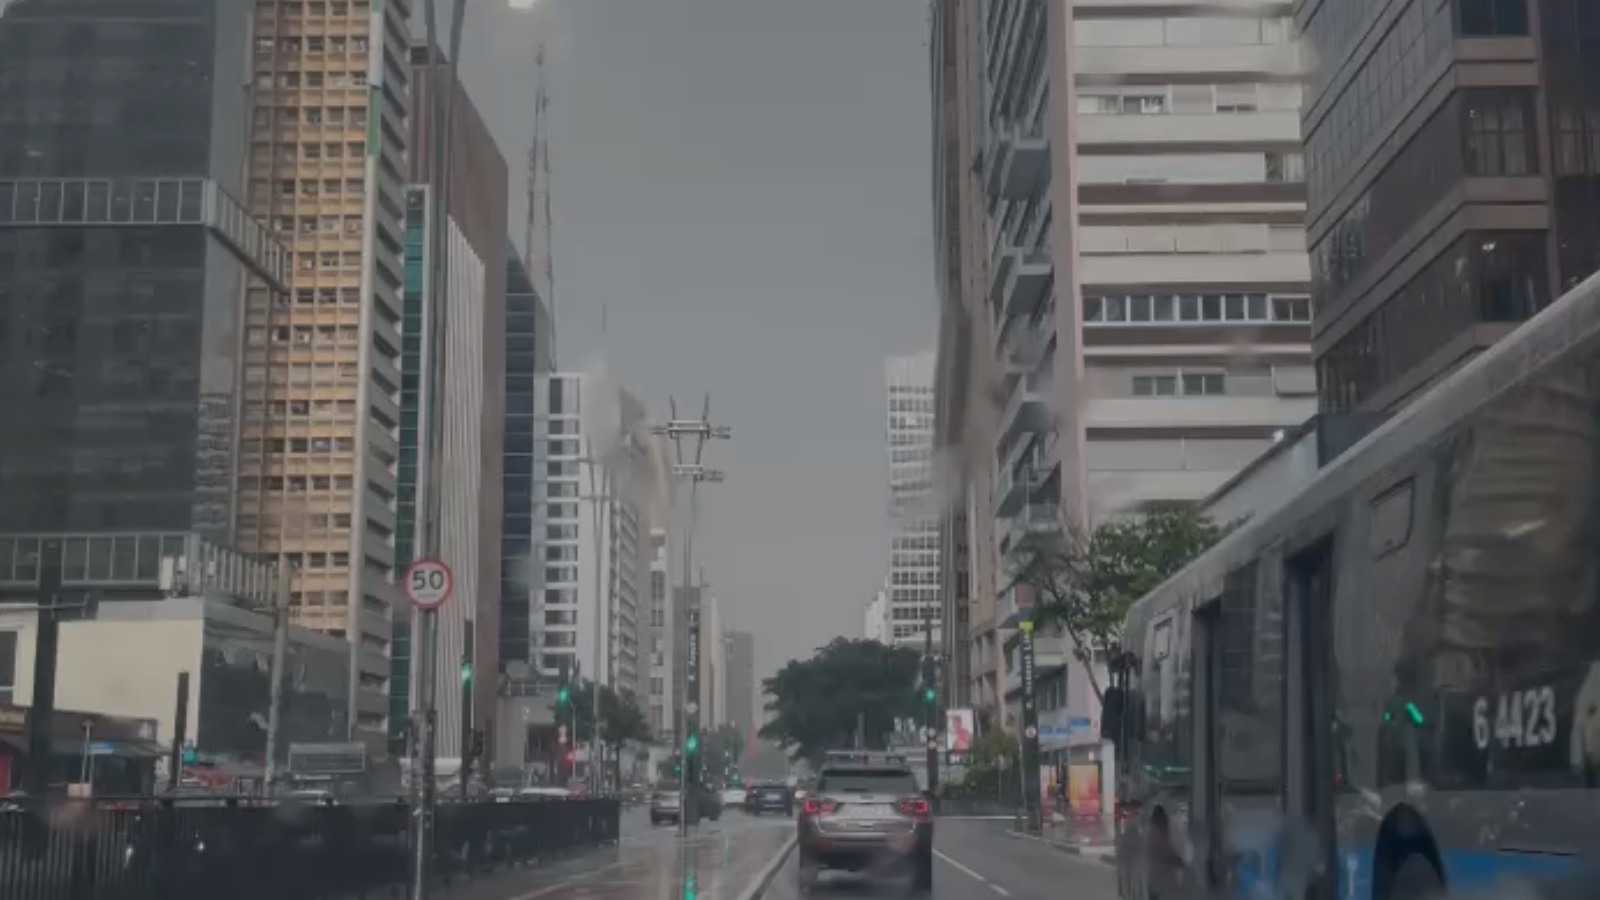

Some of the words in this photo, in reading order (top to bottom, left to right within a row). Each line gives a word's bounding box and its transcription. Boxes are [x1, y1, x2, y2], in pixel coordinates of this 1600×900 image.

[413, 570, 444, 590] 50
[1473, 696, 1490, 749] 6
[1494, 686, 1557, 748] 4423
